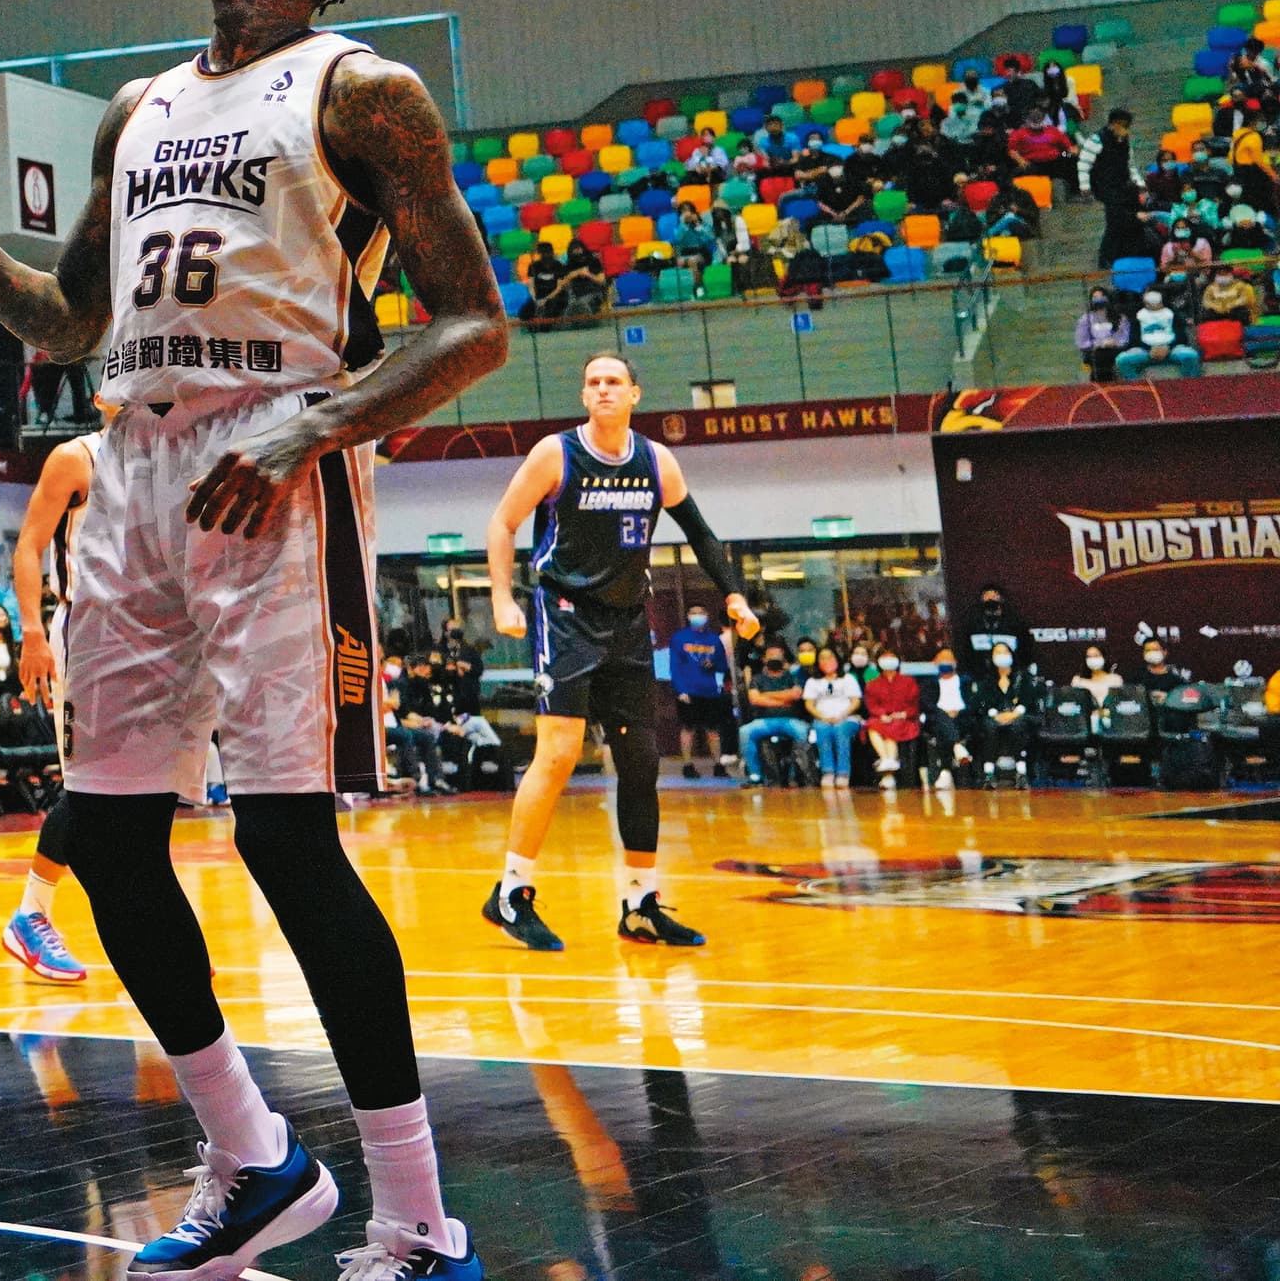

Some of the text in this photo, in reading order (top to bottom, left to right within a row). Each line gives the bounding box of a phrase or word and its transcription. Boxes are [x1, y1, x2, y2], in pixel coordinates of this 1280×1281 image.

[153, 130, 249, 163] GHOST
[125, 156, 278, 218] HAWKS
[132, 227, 224, 311] 36
[107, 334, 282, 381] 台灣鋼鐵集團
[704, 405, 895, 436] GHOST HAWKS
[622, 515, 650, 546] 23
[1055, 512, 1280, 587] GHOSTHA
